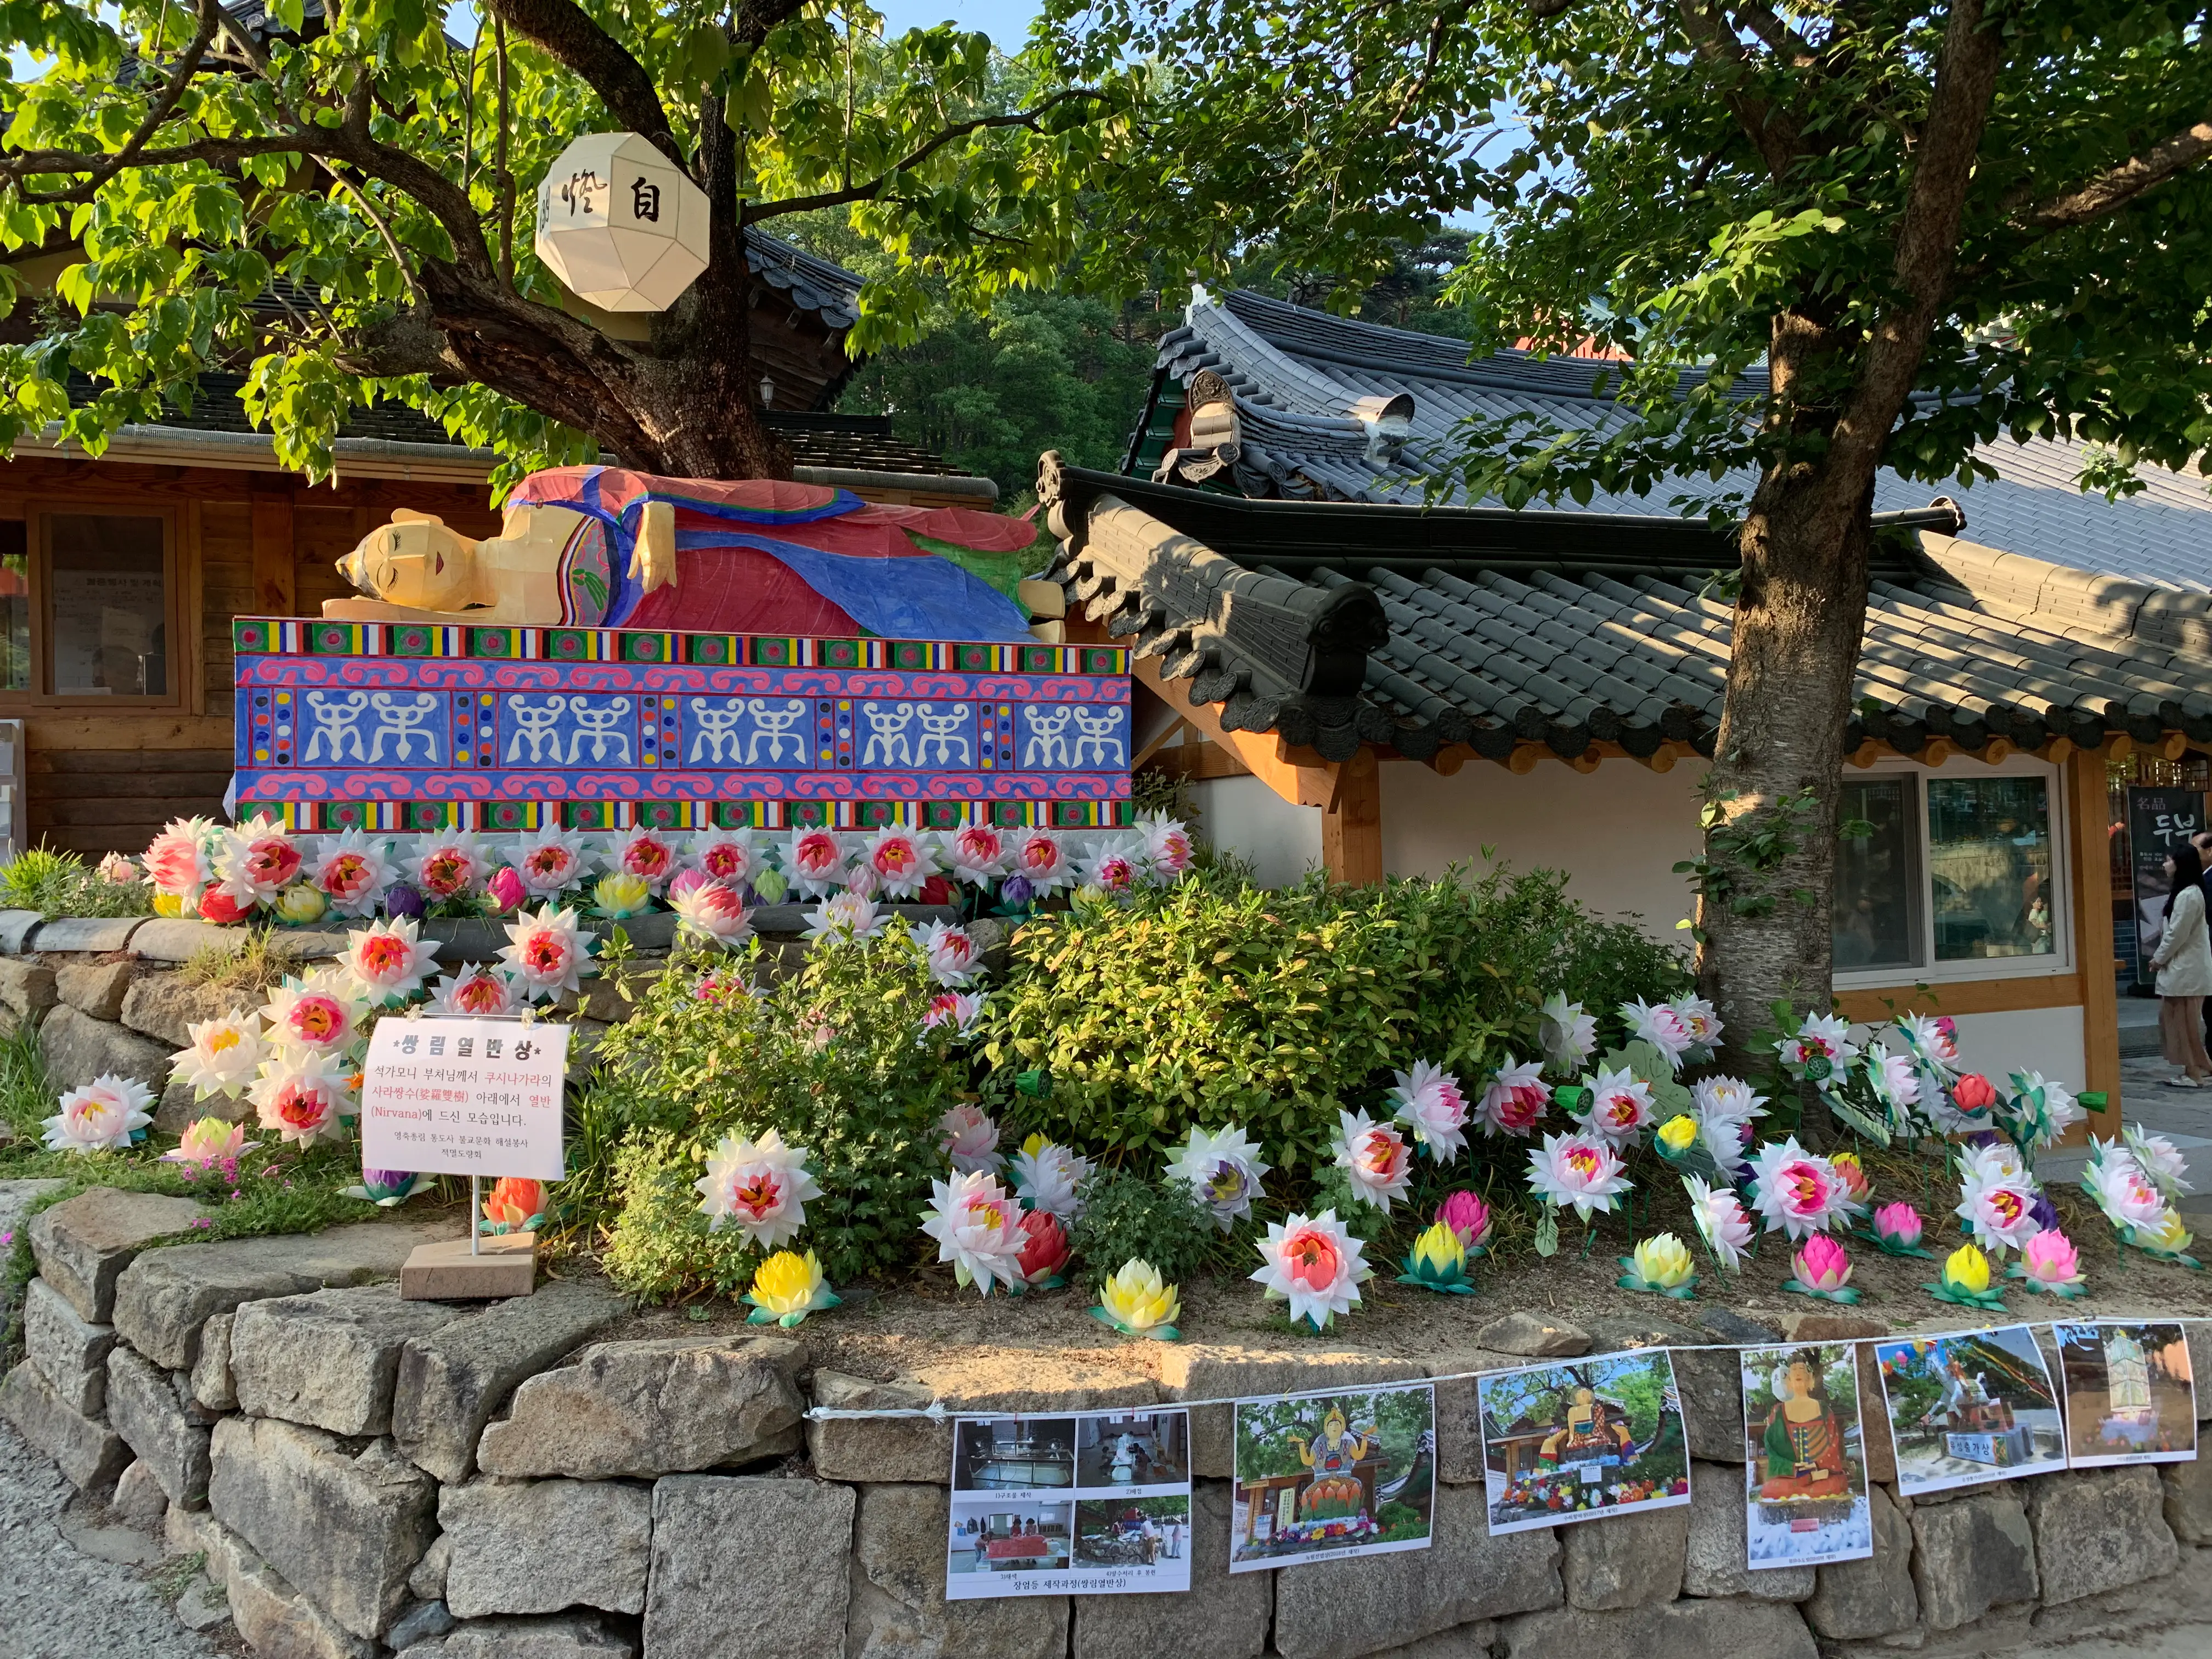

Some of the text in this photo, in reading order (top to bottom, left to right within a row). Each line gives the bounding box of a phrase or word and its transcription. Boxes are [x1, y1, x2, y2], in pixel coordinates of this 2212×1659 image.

[2137, 797, 2166, 810] 名品
[2153, 814, 2197, 847] 두부
[374, 1065, 551, 1087] 석가모니 부처님께서 쿠시나가라의
[476, 1092, 520, 1106] 아래에서
[529, 1095, 551, 1108] 열반
[371, 1105, 527, 1127] (Nirvana)에 드신 모습입니다.
[394, 1131, 528, 1148] 영축총림 통도사 불교문화 해설봉사
[441, 1148, 482, 1159] 적멸도량회
[1013, 1578, 1126, 1590] 장엄등 제작과정(쌍림열반상)
